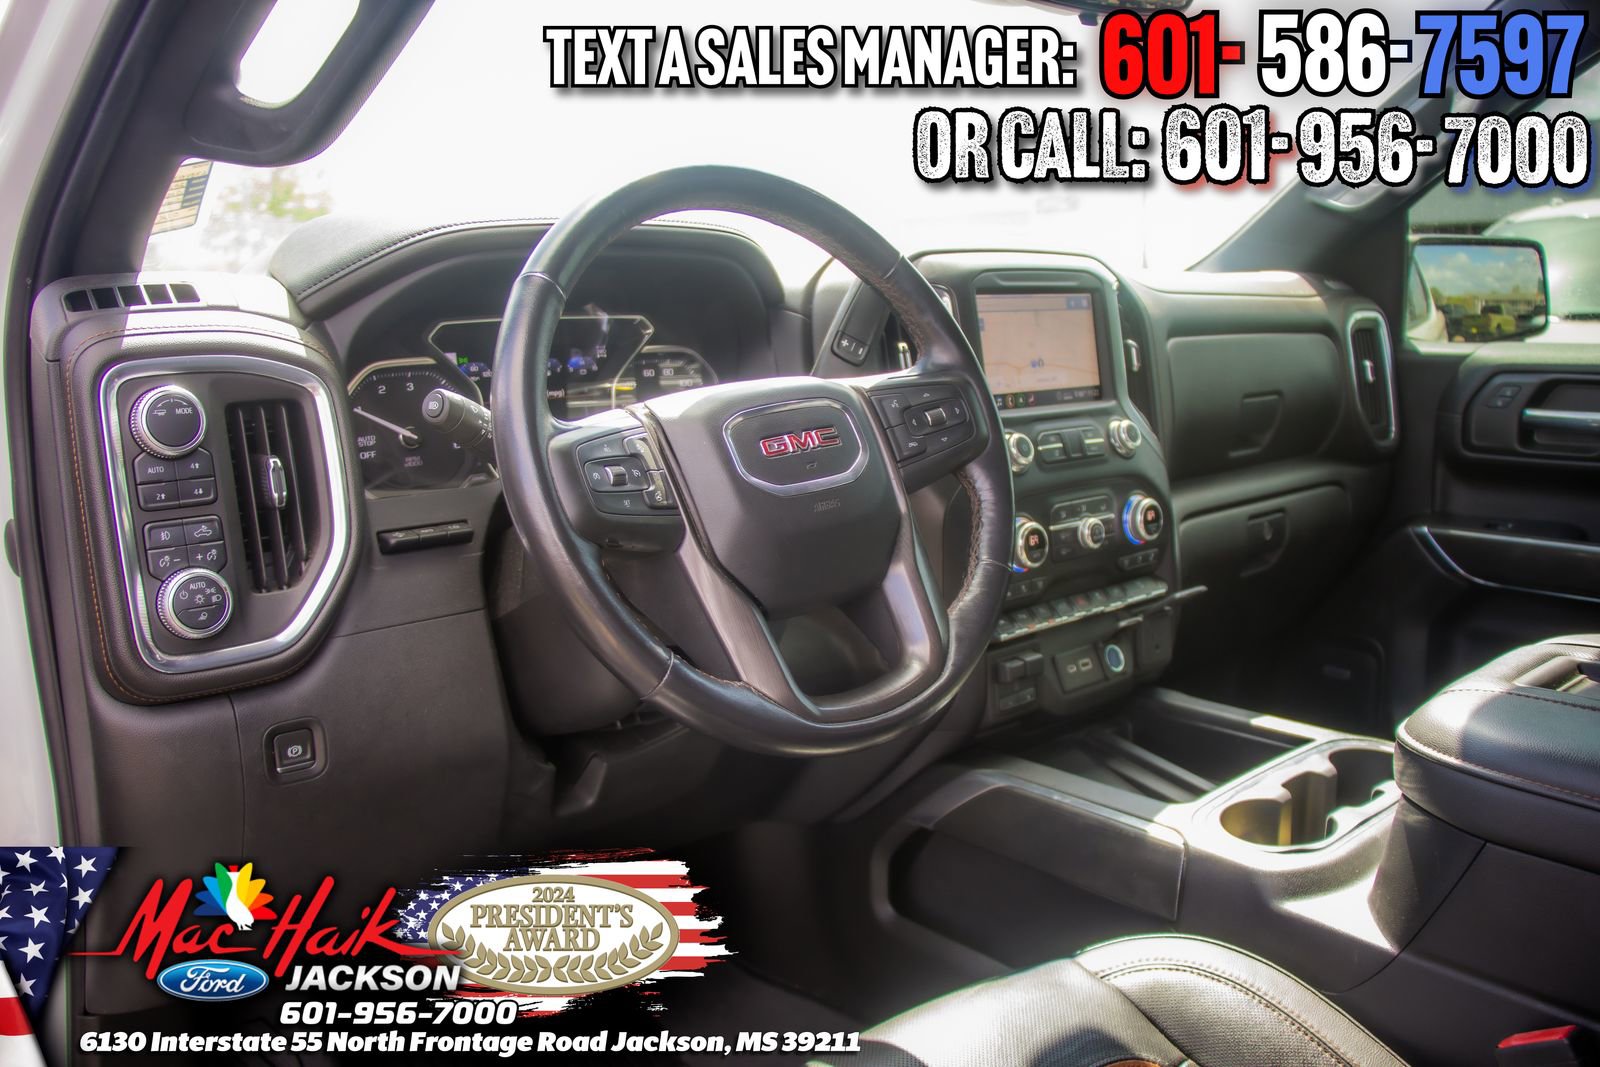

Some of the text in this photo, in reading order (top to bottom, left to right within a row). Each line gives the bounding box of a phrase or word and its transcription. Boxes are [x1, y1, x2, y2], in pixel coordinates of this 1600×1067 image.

[378, 386, 386, 394] 2
[407, 382, 414, 391] 3
[175, 406, 193, 416] MODE
[760, 427, 841, 459] GMC
[360, 450, 376, 459] OFF
[147, 465, 165, 474] AUTO
[189, 581, 206, 590] AUTO
